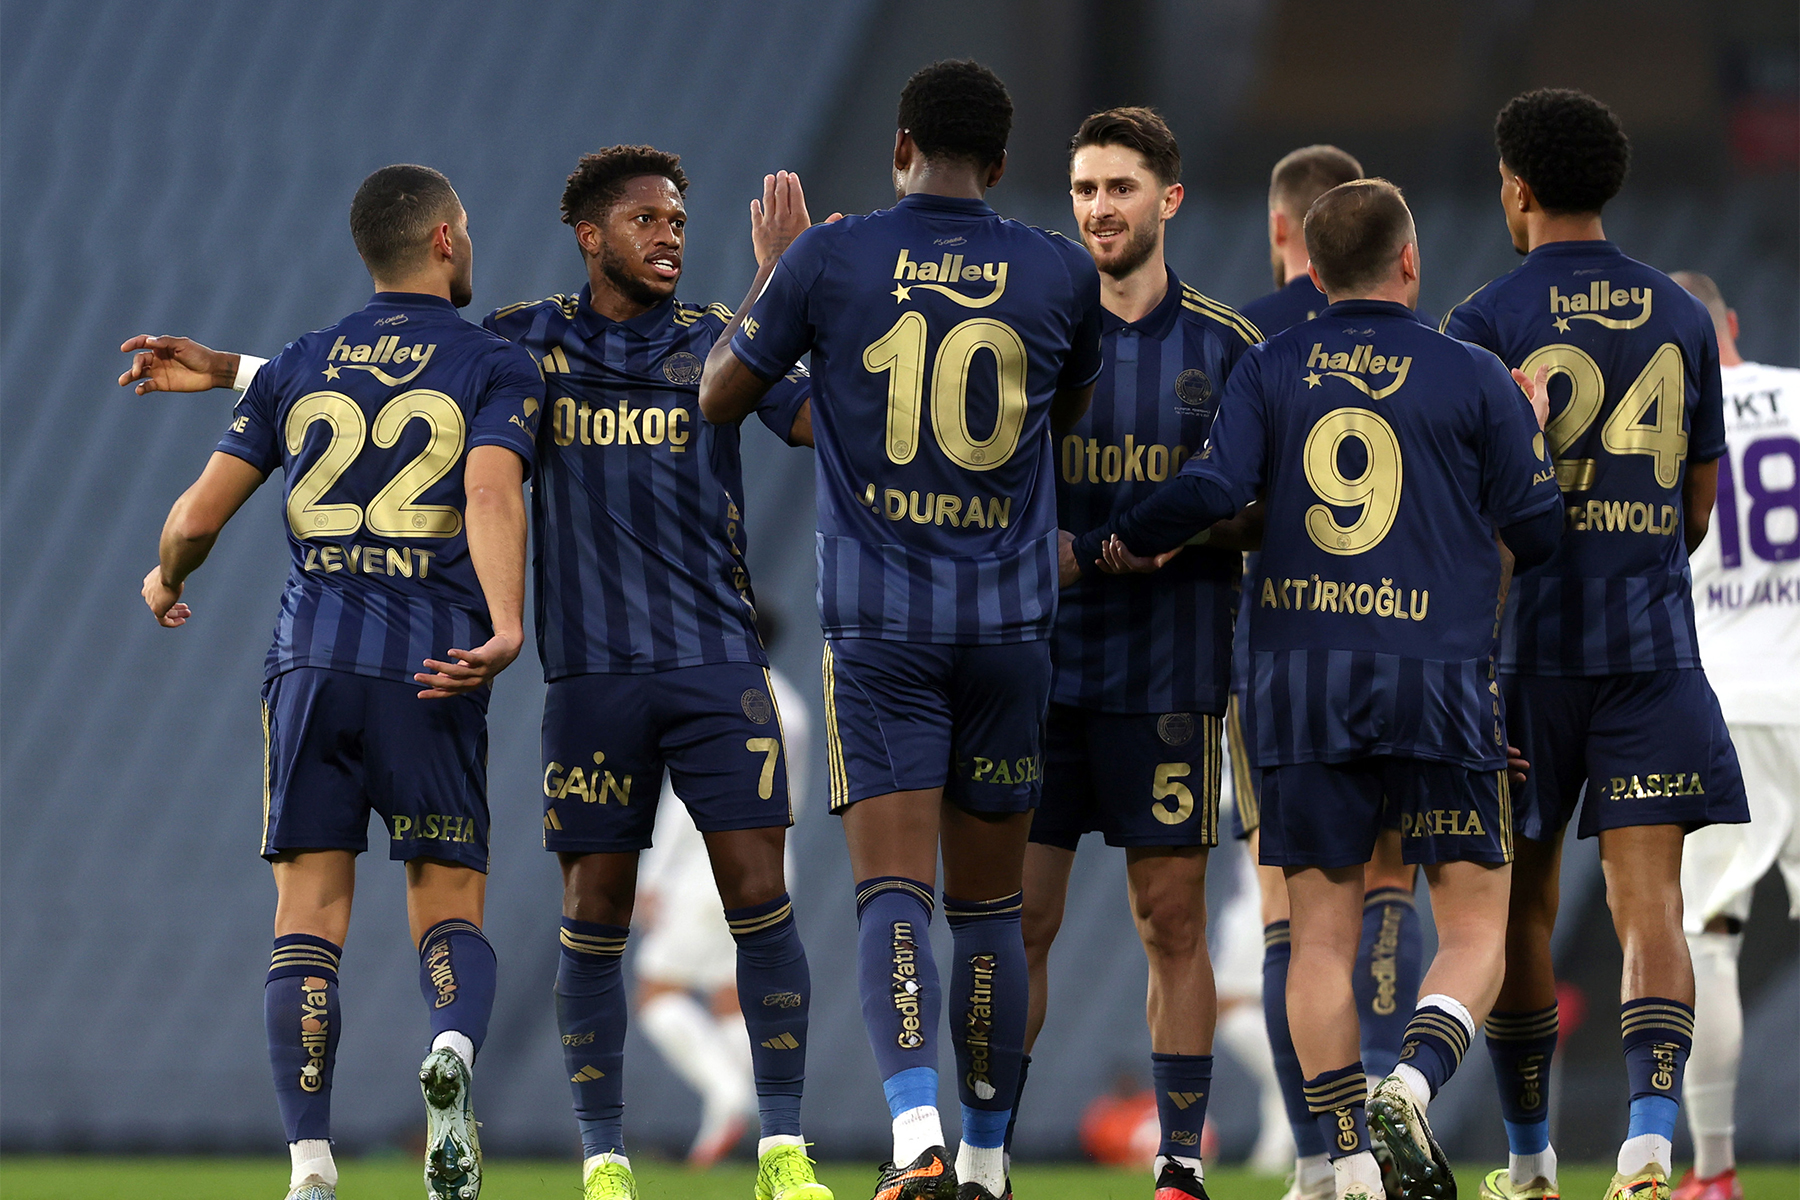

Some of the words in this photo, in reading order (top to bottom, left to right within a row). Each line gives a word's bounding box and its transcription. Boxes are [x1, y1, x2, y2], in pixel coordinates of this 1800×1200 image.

[893, 249, 1008, 309] halley
[1550, 281, 1653, 329] halley
[327, 335, 437, 387] halley
[1306, 343, 1413, 400] halley
[862, 310, 1028, 471] 10
[1519, 342, 1688, 492] 24
[1724, 389, 1782, 418] KT
[553, 396, 690, 453] Otokoç
[284, 388, 466, 540] 22
[1302, 407, 1403, 556] 9
[1716, 433, 1800, 570] 18
[304, 545, 436, 579] LEVENT
[1260, 574, 1430, 622] AKTÜRKOĞLU
[746, 738, 779, 800] 7
[1152, 762, 1194, 825] 5
[1609, 772, 1705, 801] PASHA
[391, 814, 475, 844] PASHA
[1401, 809, 1486, 839] PASHA
